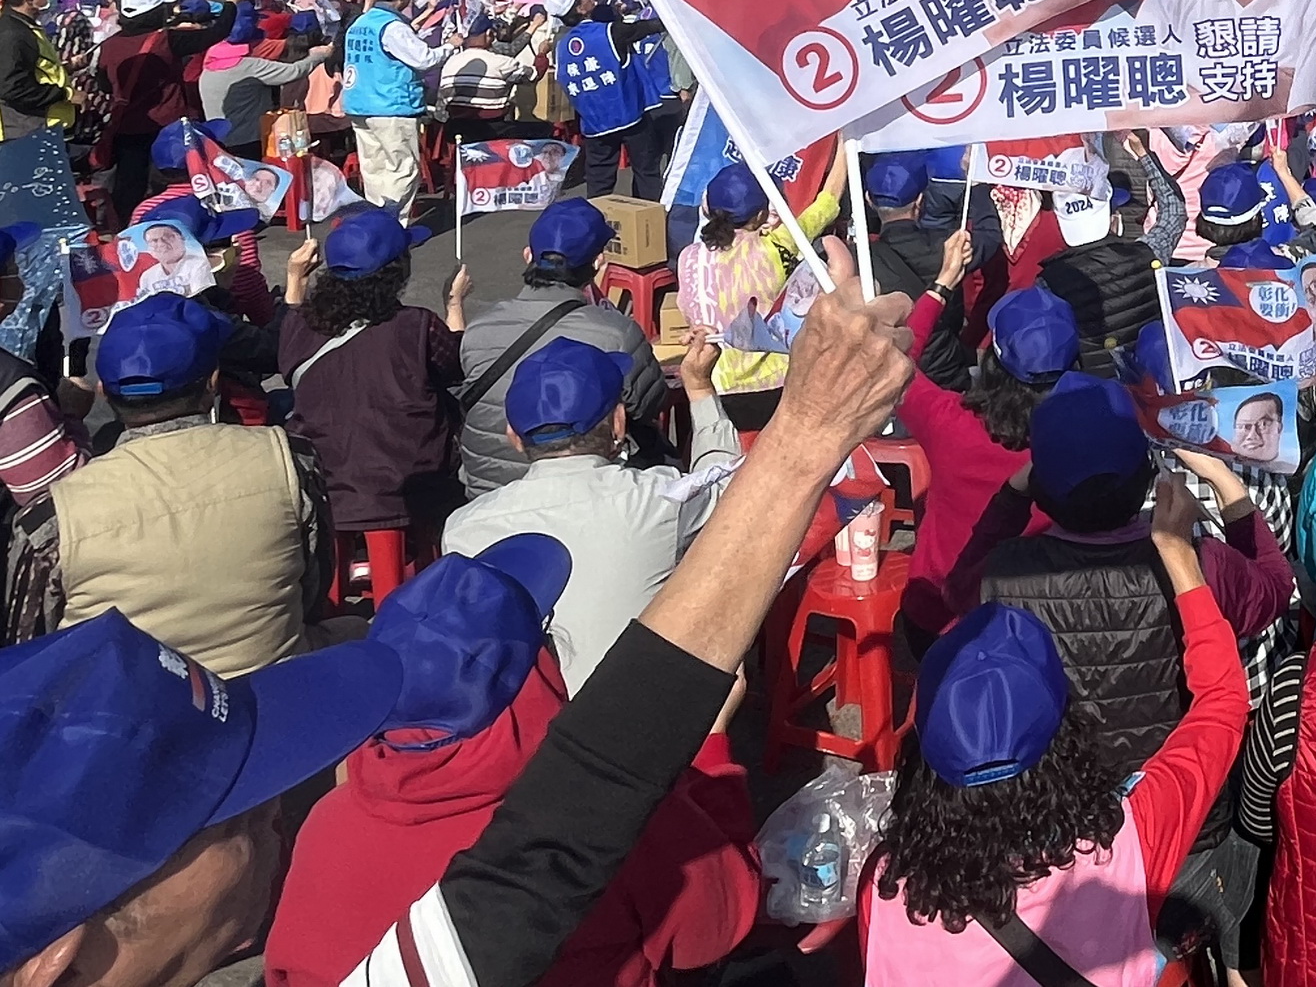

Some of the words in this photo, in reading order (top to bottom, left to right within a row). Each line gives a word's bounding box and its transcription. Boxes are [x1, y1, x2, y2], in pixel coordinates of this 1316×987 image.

[1001, 24, 1183, 57] 立法委員候選人
[1193, 16, 1281, 59] 懇請
[997, 52, 1188, 118] 楊曜聰
[1199, 60, 1277, 103] 支持
[1065, 199, 1094, 214] 2024
[1258, 286, 1289, 302] 彰化
